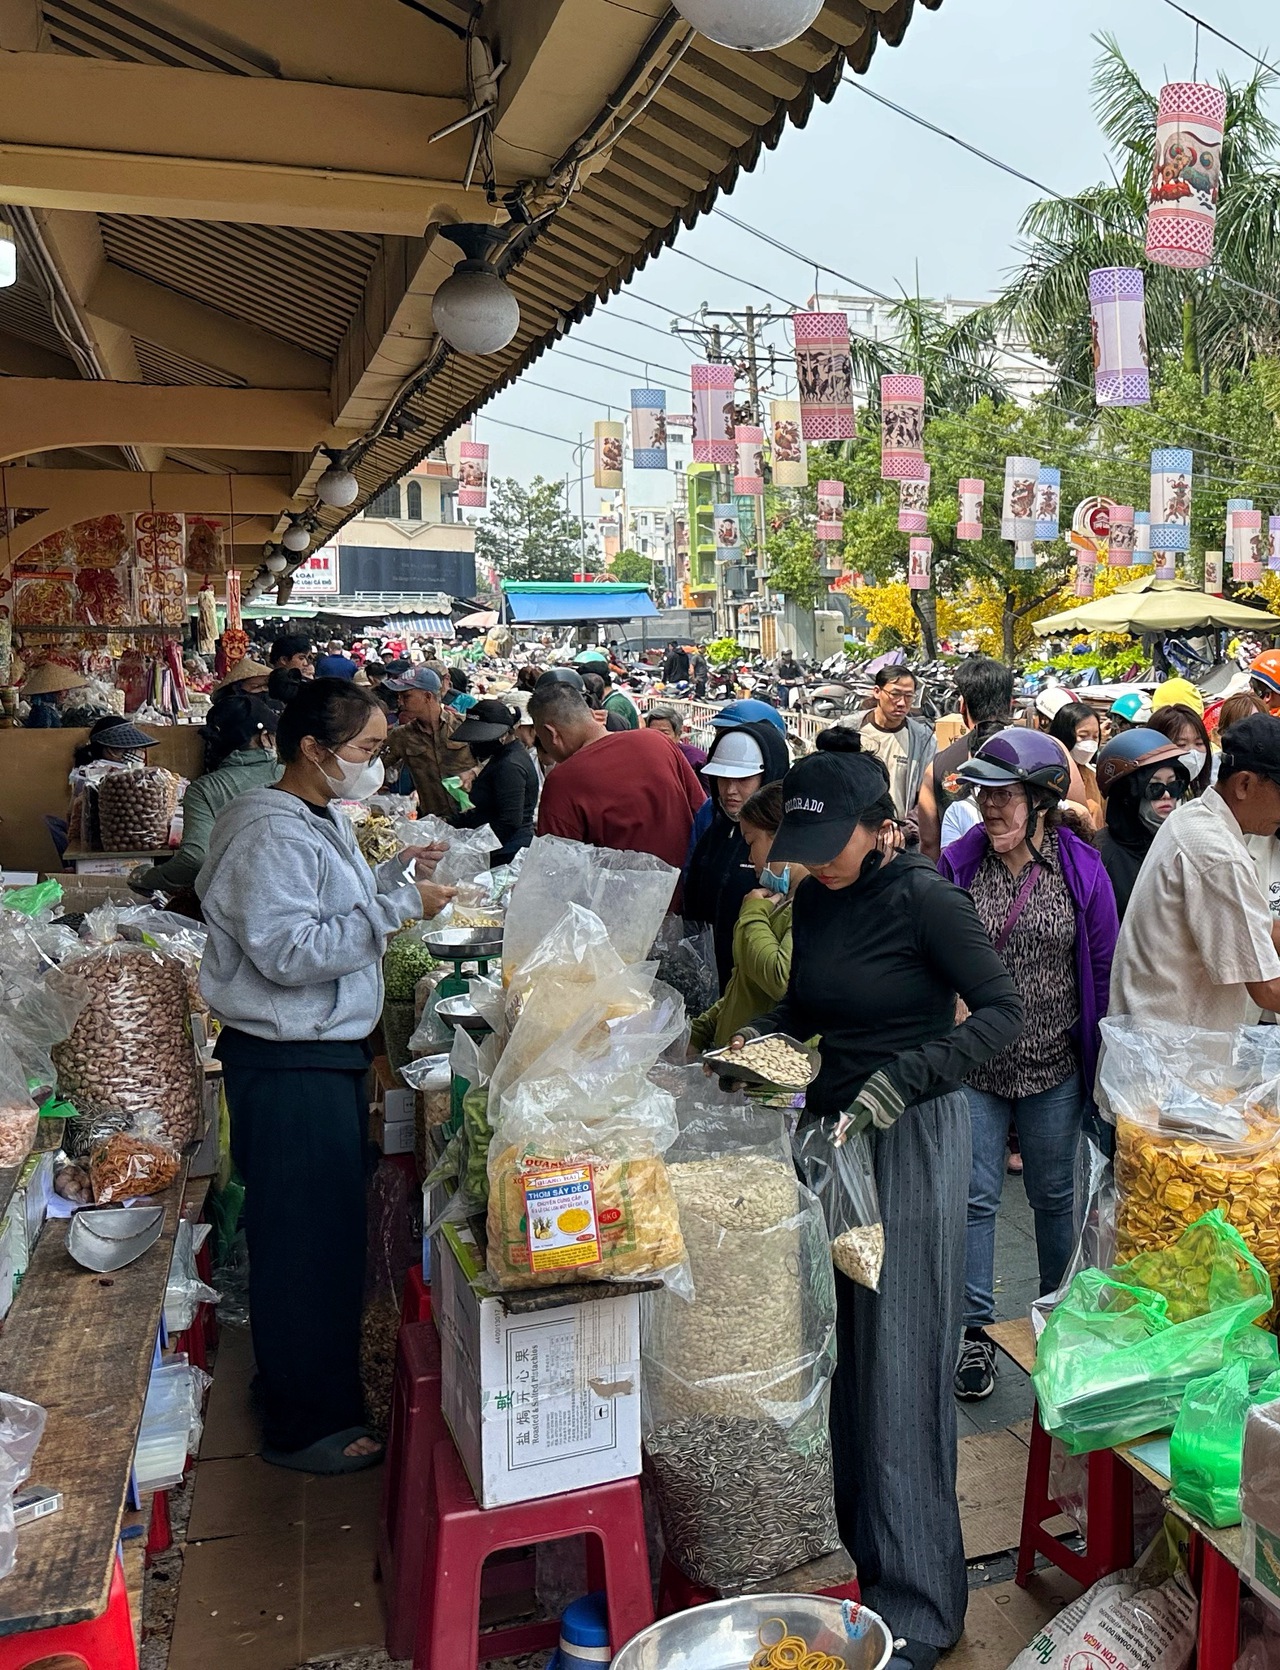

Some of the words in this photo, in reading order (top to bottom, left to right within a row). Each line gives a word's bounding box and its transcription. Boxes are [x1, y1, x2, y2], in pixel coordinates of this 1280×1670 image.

[785, 797, 825, 814] COLORADO
[531, 1414, 539, 1444] Roasted
[1112, 1631, 1131, 1651] DOANH
[1099, 1646, 1118, 1664] CON
